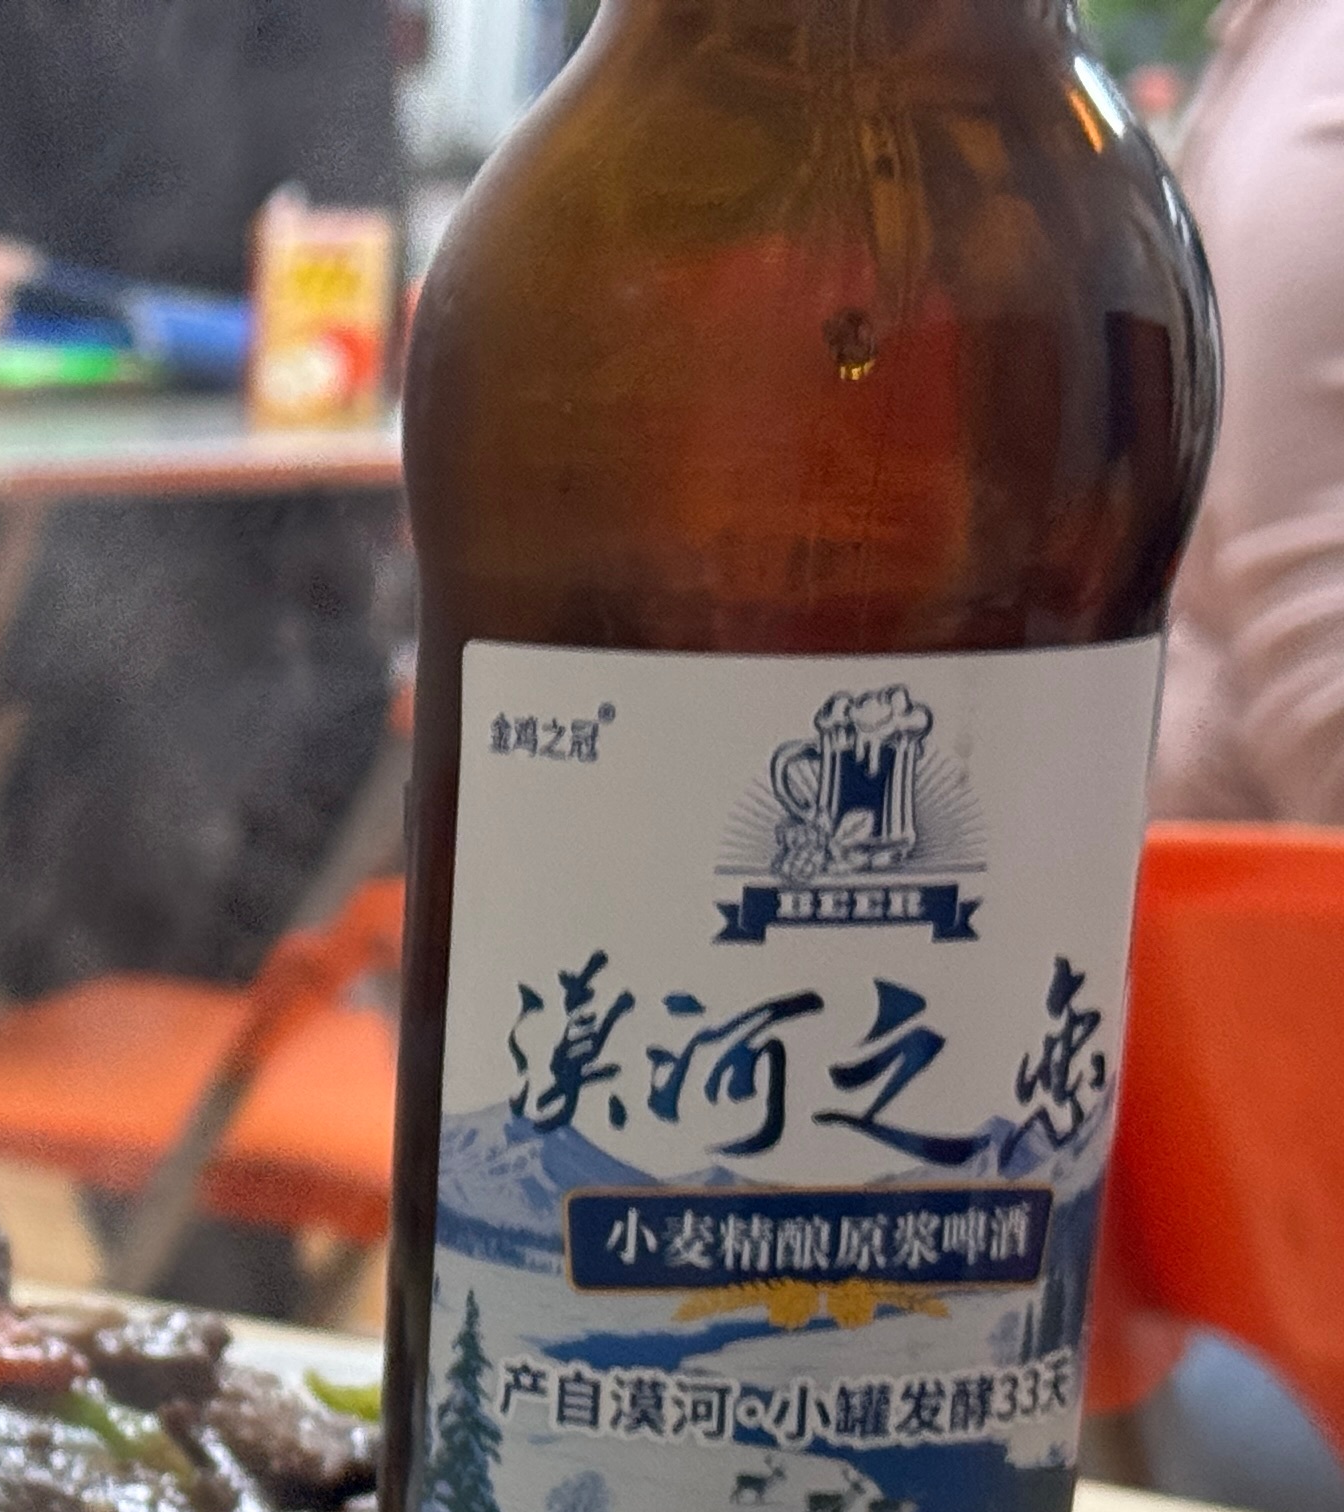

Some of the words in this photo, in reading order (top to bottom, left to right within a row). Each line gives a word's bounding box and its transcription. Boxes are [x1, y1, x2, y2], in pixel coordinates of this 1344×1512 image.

[776, 891, 925, 920] BEER
[606, 1204, 1030, 1272] 小麦精酿原浆啤酒
